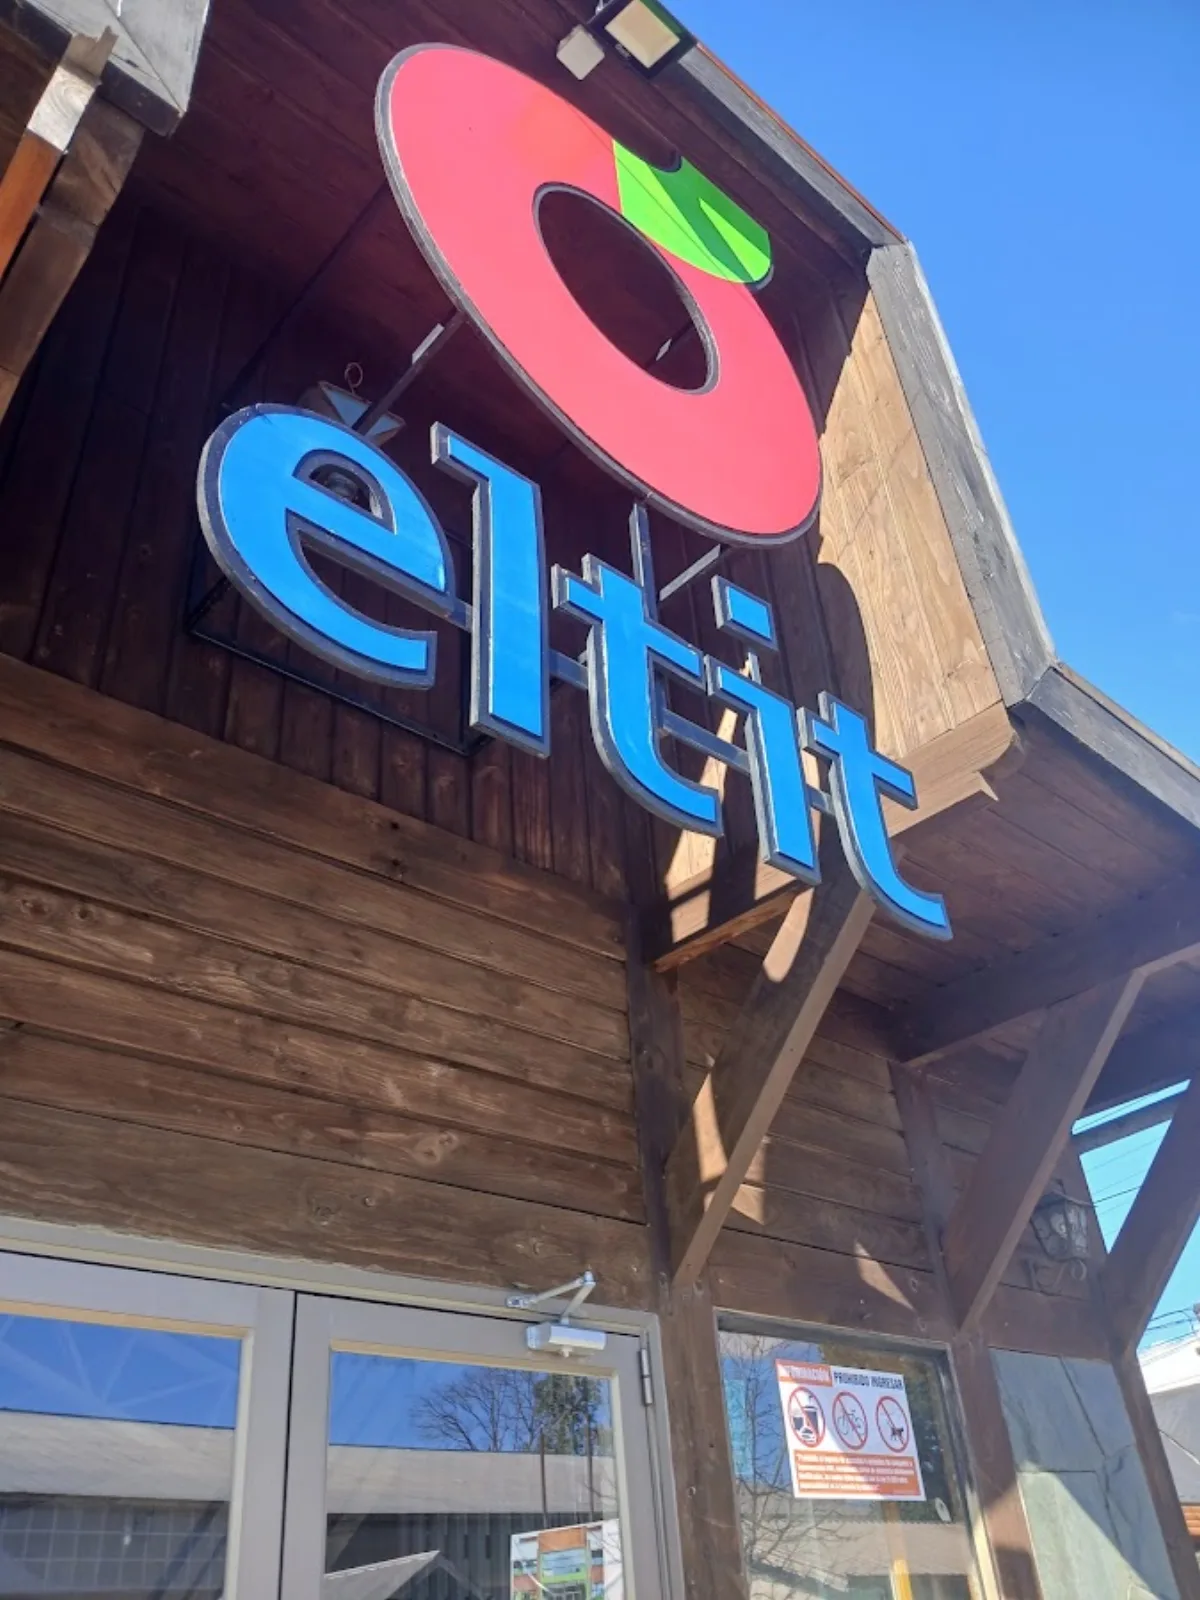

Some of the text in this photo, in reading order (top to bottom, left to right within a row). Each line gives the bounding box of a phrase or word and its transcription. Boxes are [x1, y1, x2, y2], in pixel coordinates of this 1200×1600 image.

[197, 403, 953, 940] eltit
[834, 1371, 904, 1390] PROHIBIDO INGRESAR
